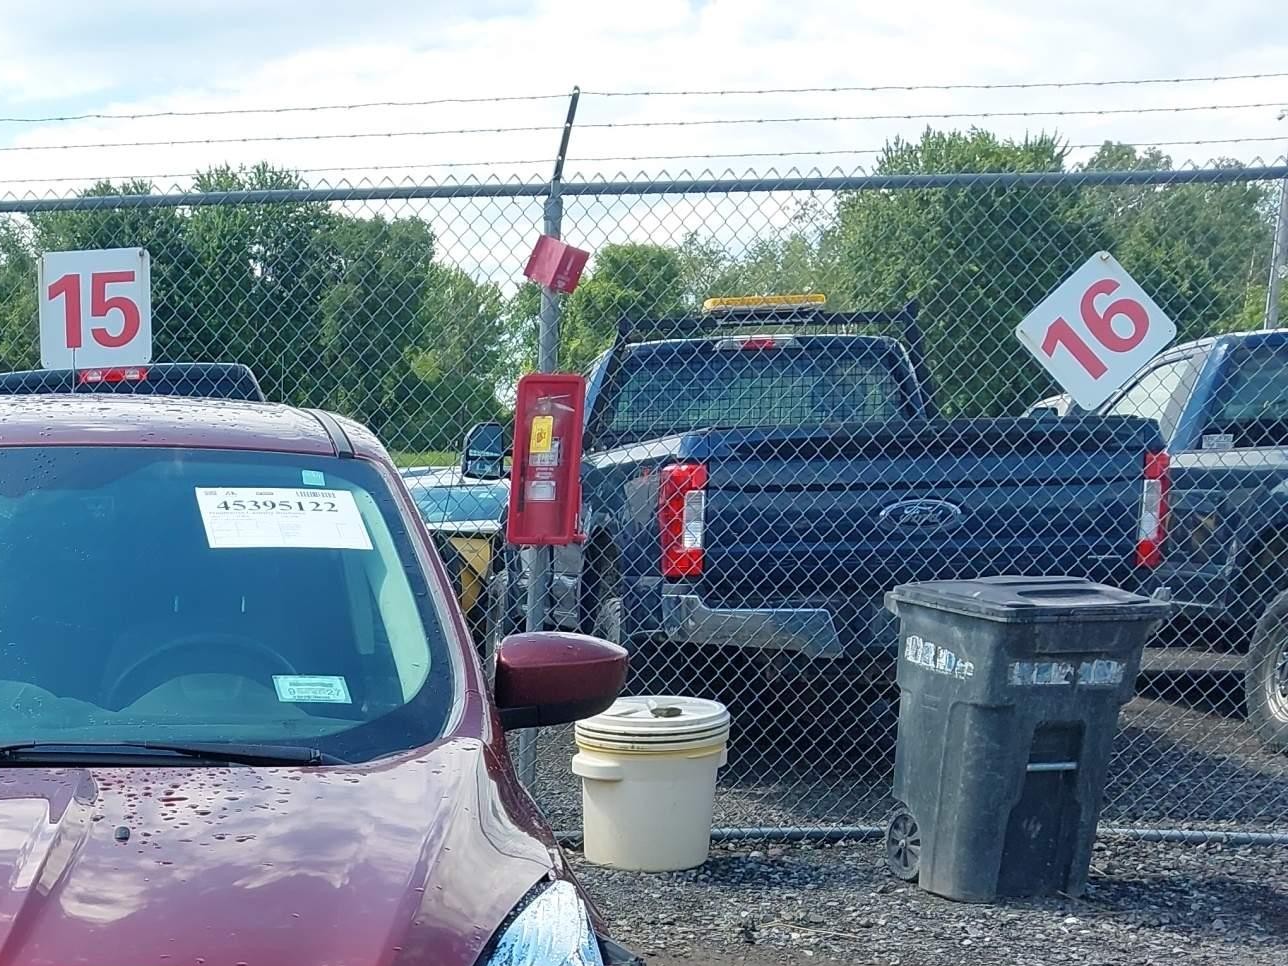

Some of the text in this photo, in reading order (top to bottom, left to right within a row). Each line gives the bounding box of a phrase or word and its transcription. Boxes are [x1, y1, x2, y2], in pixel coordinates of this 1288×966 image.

[47, 270, 141, 350] 15
[1040, 278, 1150, 381] 16
[216, 499, 339, 514] 45395122
